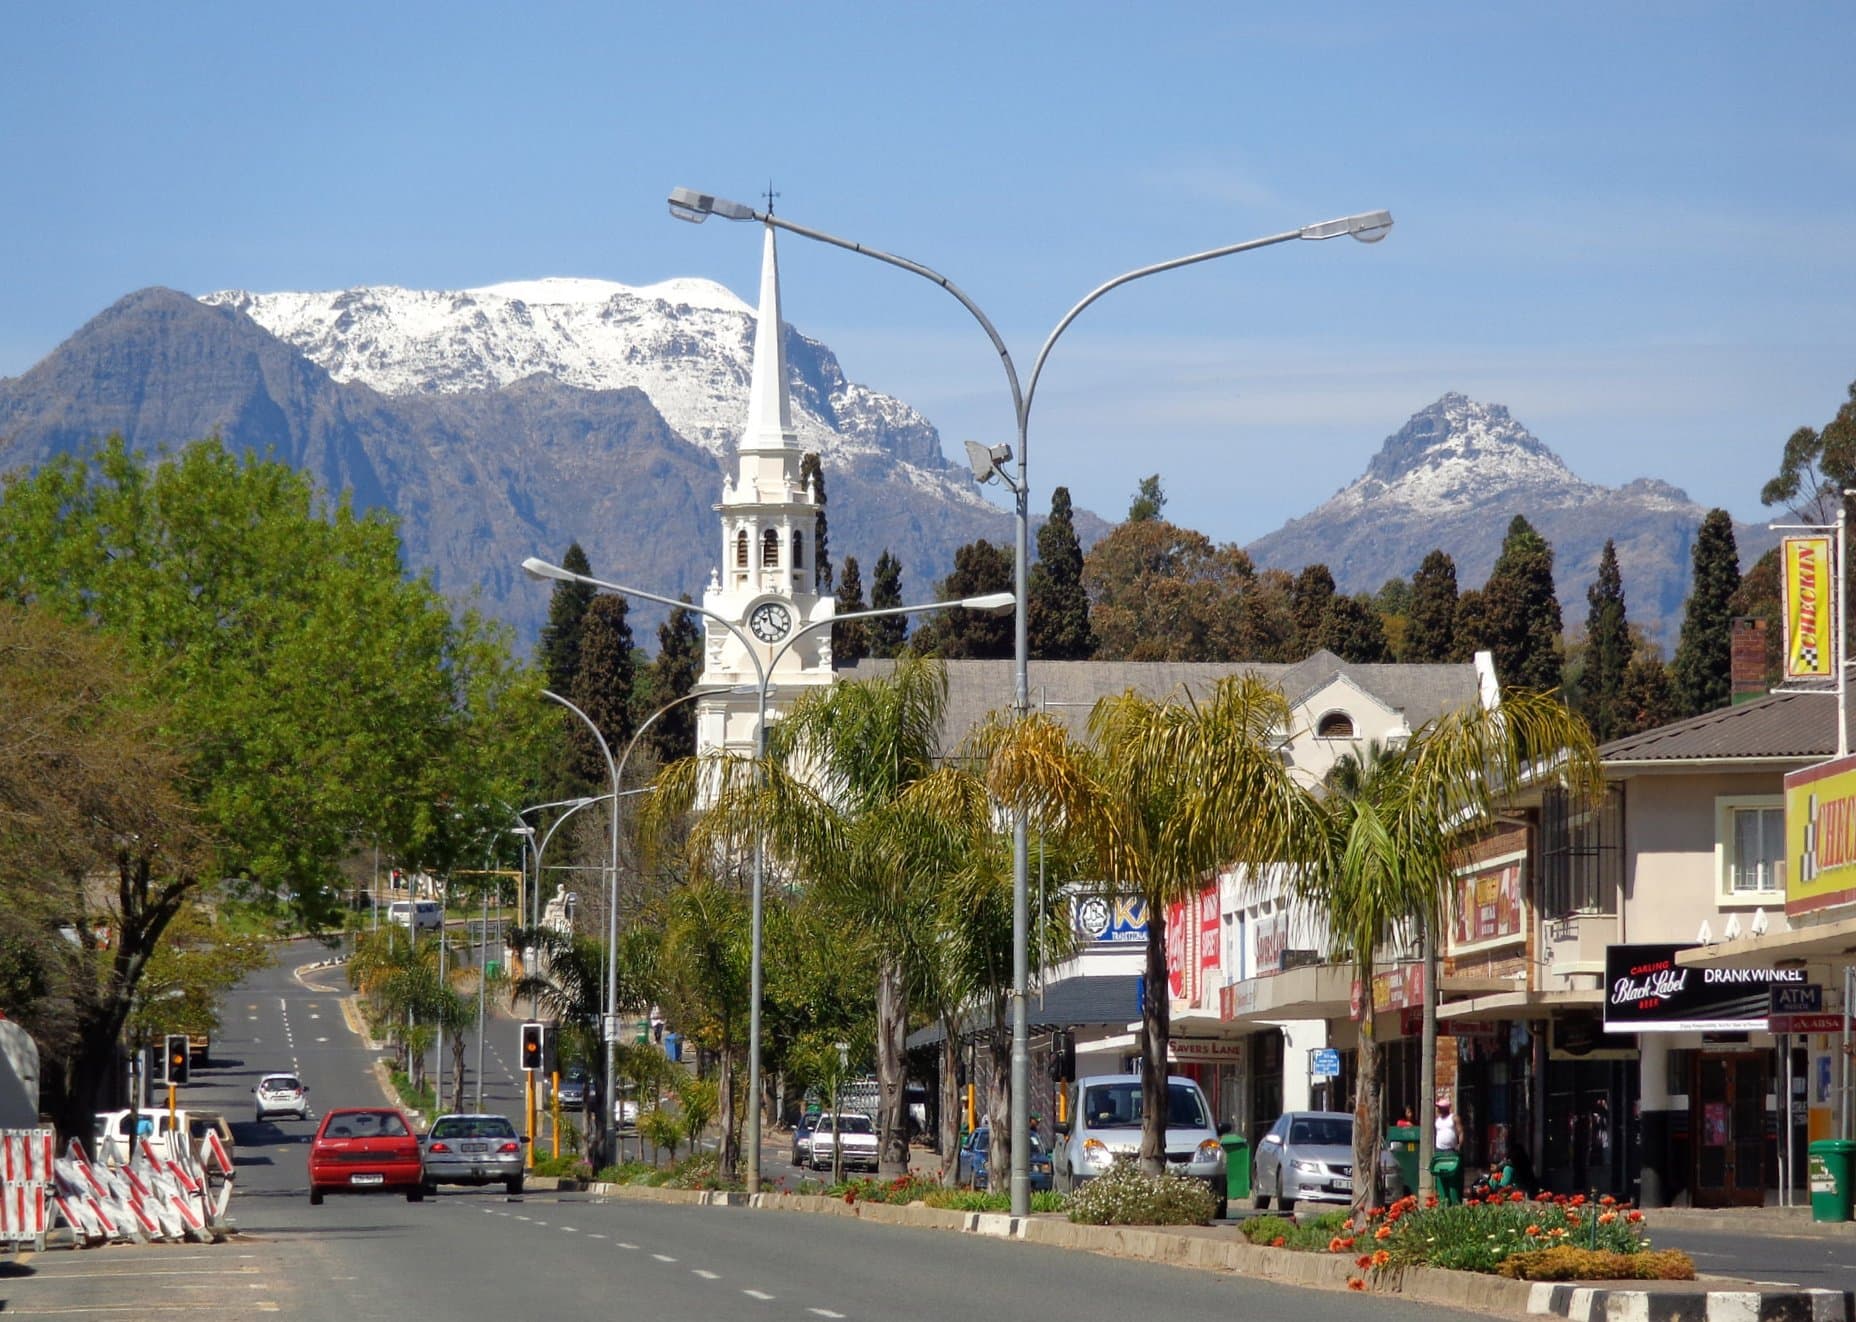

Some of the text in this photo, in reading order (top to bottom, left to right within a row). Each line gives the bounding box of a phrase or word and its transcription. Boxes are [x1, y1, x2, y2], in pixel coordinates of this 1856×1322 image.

[1799, 545, 1817, 648] CHECKIN
[1630, 961, 1670, 975] CARLING
[1704, 968, 1803, 983] DRANKWINKEL
[1611, 969, 1688, 1005] Black Label
[1779, 989, 1815, 1003] ATM
